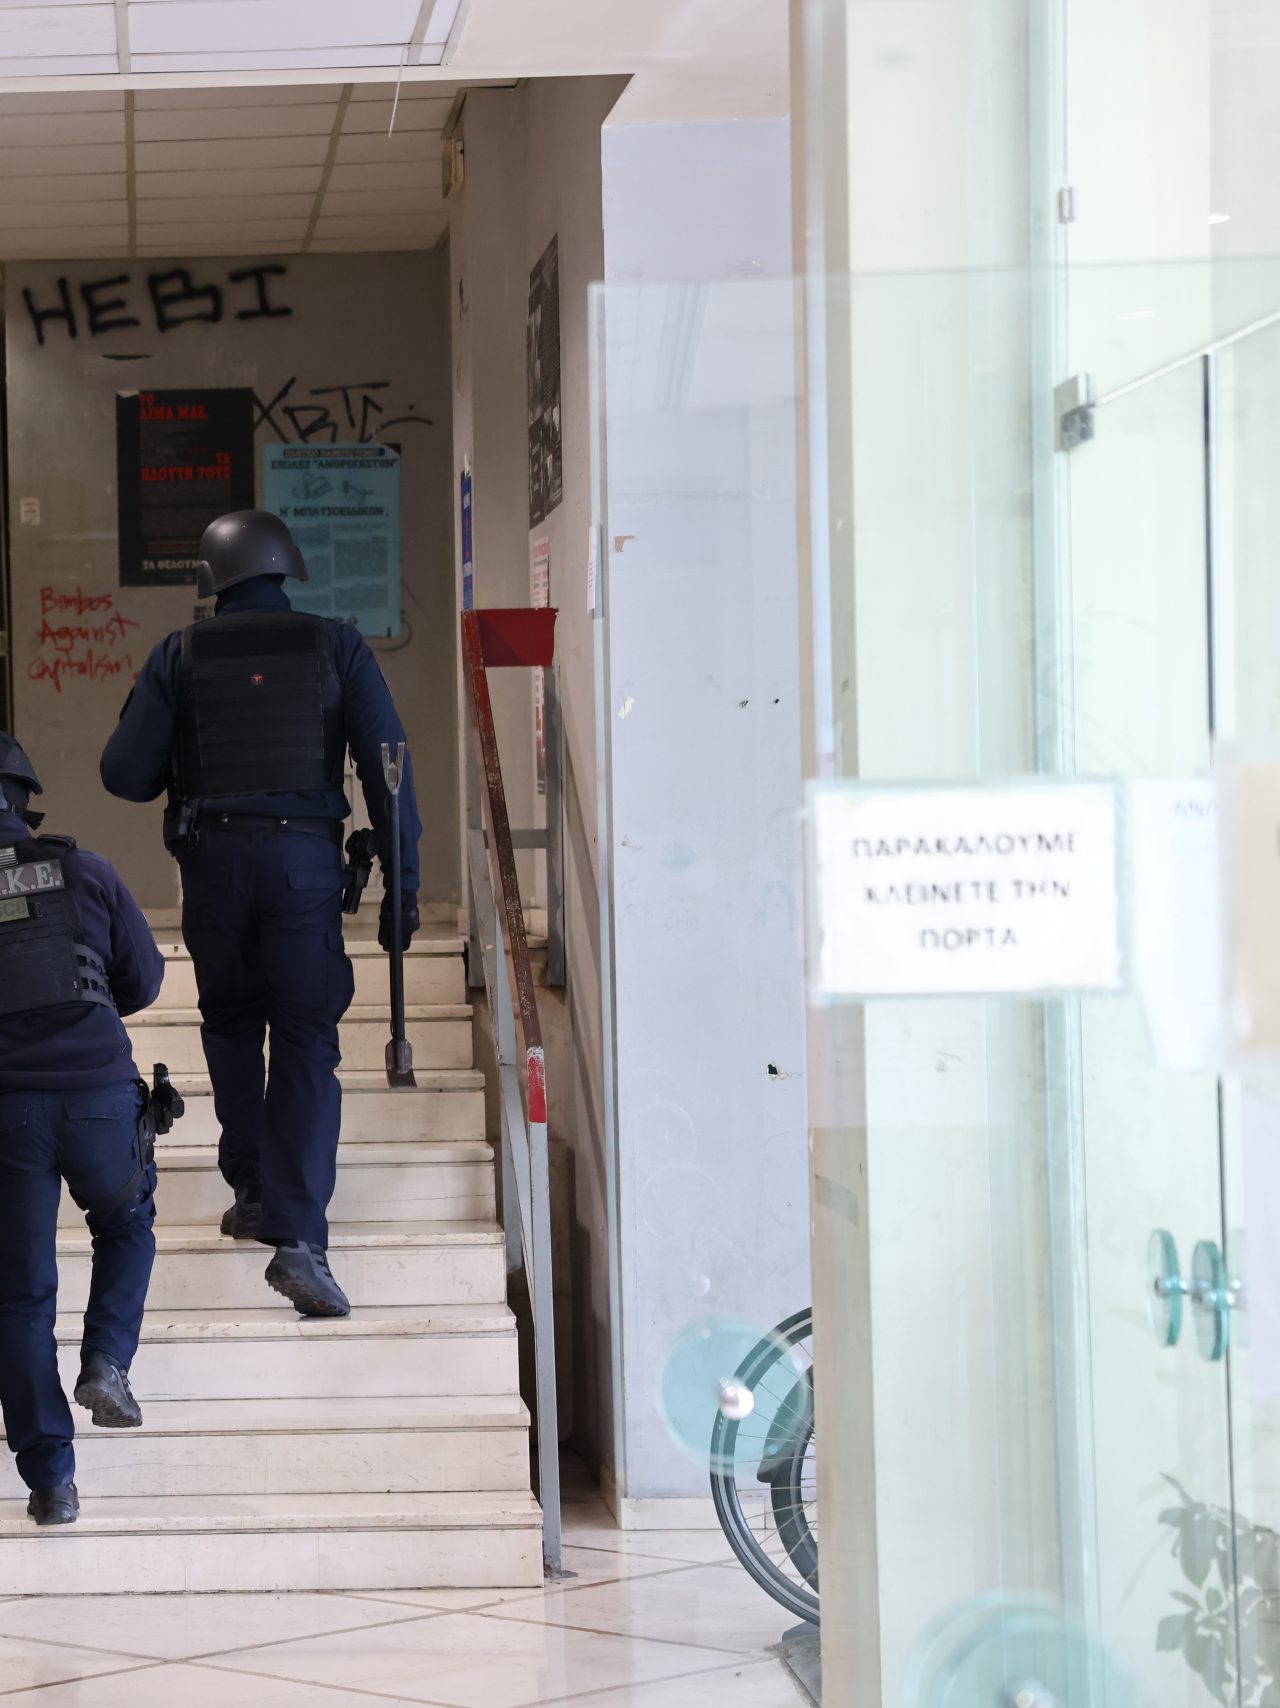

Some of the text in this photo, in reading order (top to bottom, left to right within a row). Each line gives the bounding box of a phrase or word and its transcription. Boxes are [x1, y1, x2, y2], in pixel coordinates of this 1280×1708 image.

[23, 265, 293, 345] HEBI
[140, 406, 174, 420] ΑΙΜΑ
[37, 611, 140, 661] Against
[852, 832, 1077, 858] ΠΑΡΑΚΑΛΟΥΜΕ
[865, 879, 1070, 904] ΚΛΕΙΝΕΤΕ ΤΗΝ
[920, 927, 1017, 950] ΠΟΡΤΑ
